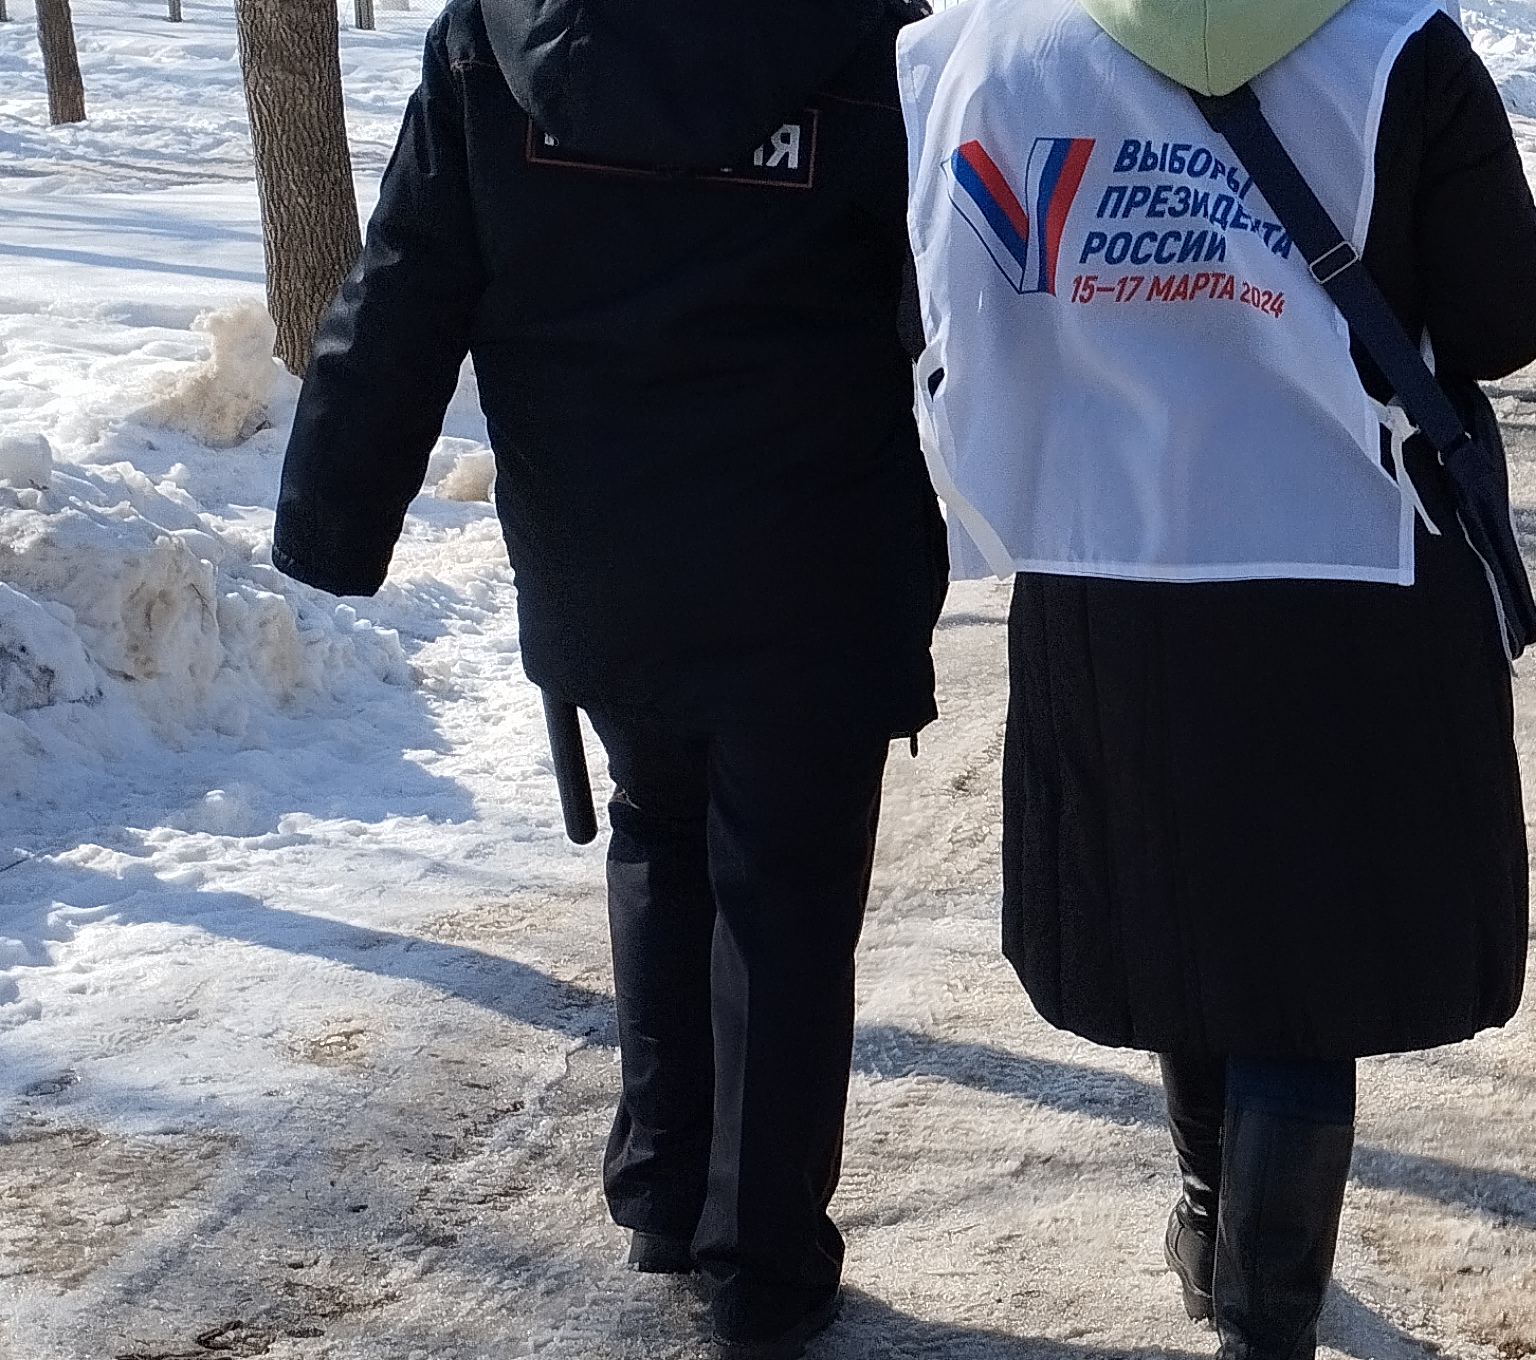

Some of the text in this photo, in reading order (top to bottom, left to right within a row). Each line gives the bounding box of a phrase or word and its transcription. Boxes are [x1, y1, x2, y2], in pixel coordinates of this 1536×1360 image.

[1113, 139, 1253, 200] ВЫБОРЫ
[1079, 229, 1227, 265] РОССИИ
[1146, 272, 1235, 302] МАРТА
[1240, 281, 1286, 318] 2024
